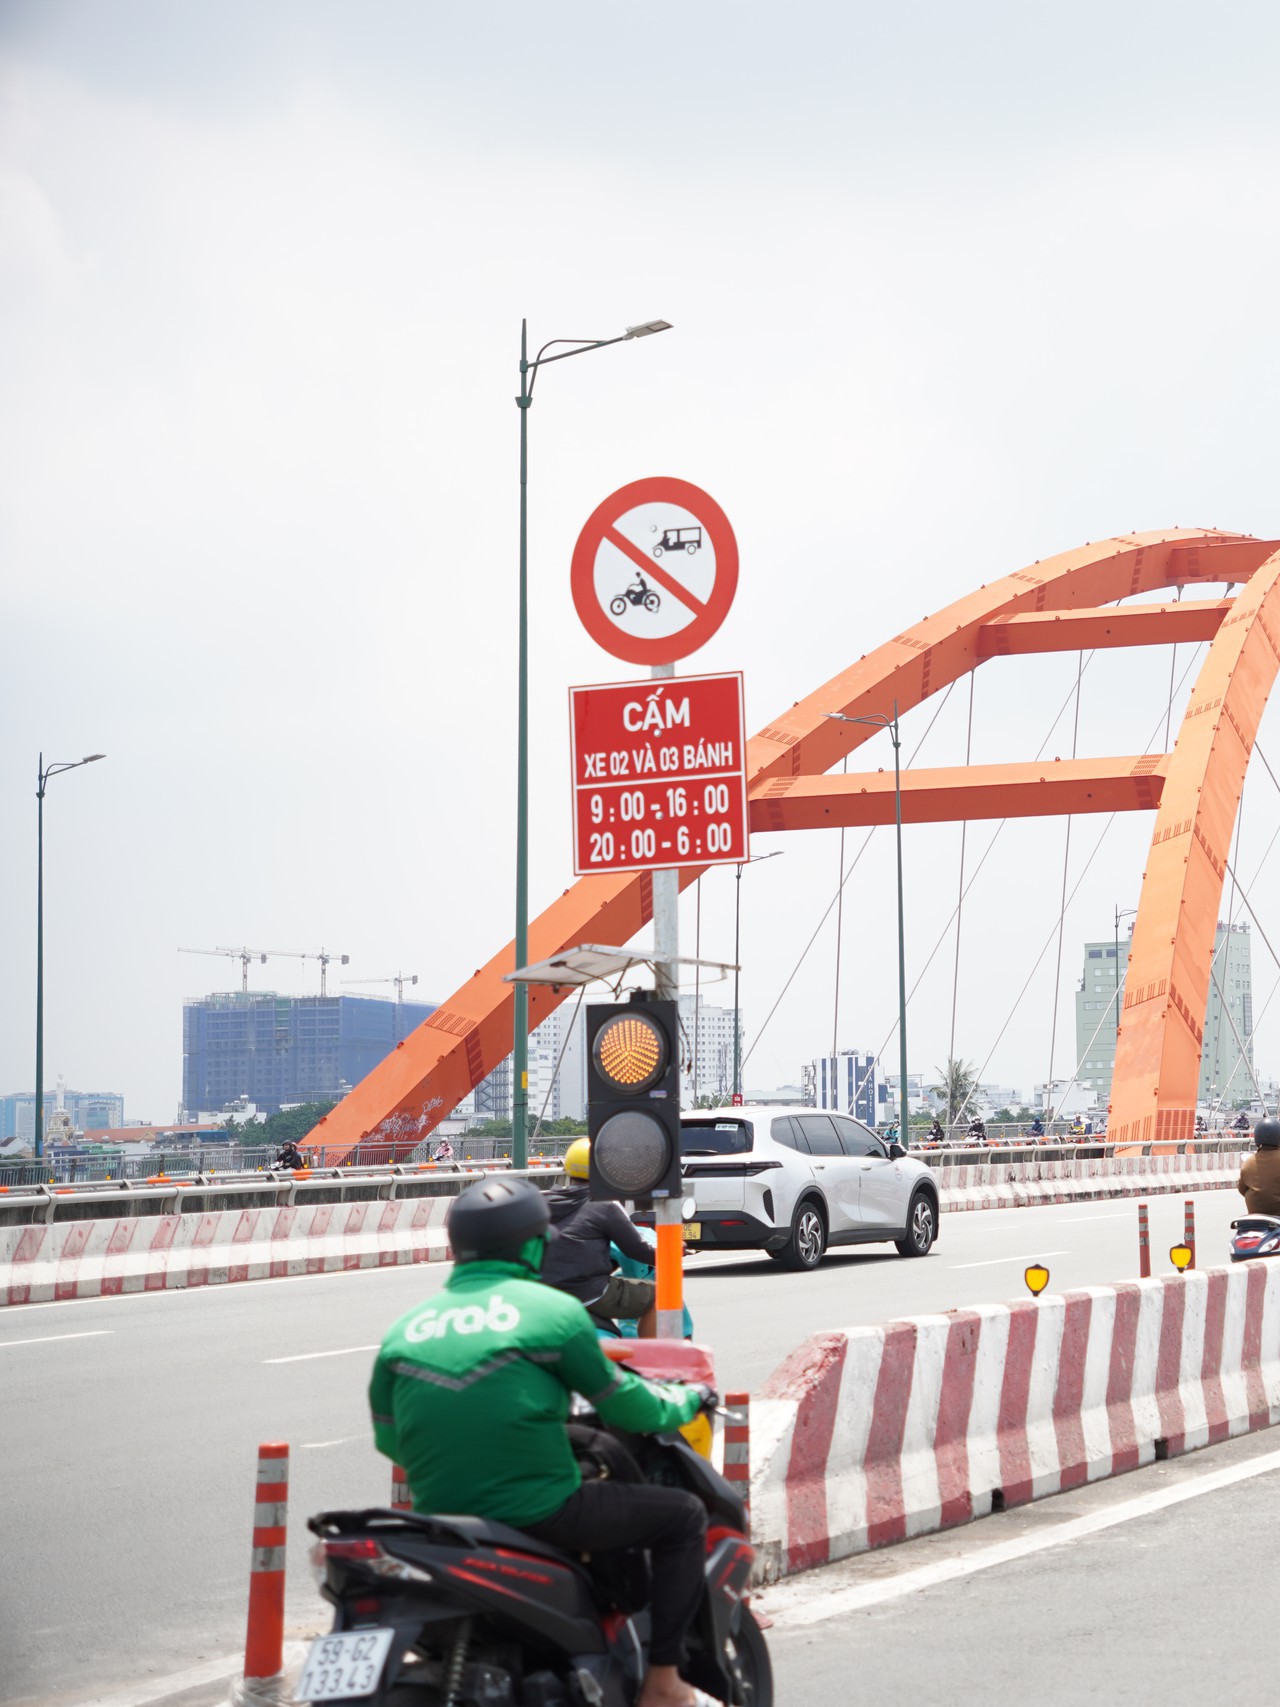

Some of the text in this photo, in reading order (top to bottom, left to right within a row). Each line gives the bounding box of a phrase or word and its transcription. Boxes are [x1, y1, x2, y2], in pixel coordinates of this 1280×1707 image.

[623, 687, 691, 732] CẤM
[584, 737, 733, 779] XE 02 VÀ 03 BÁNH
[404, 1295, 521, 1343] Grab
[303, 1665, 375, 1697] 133.43
